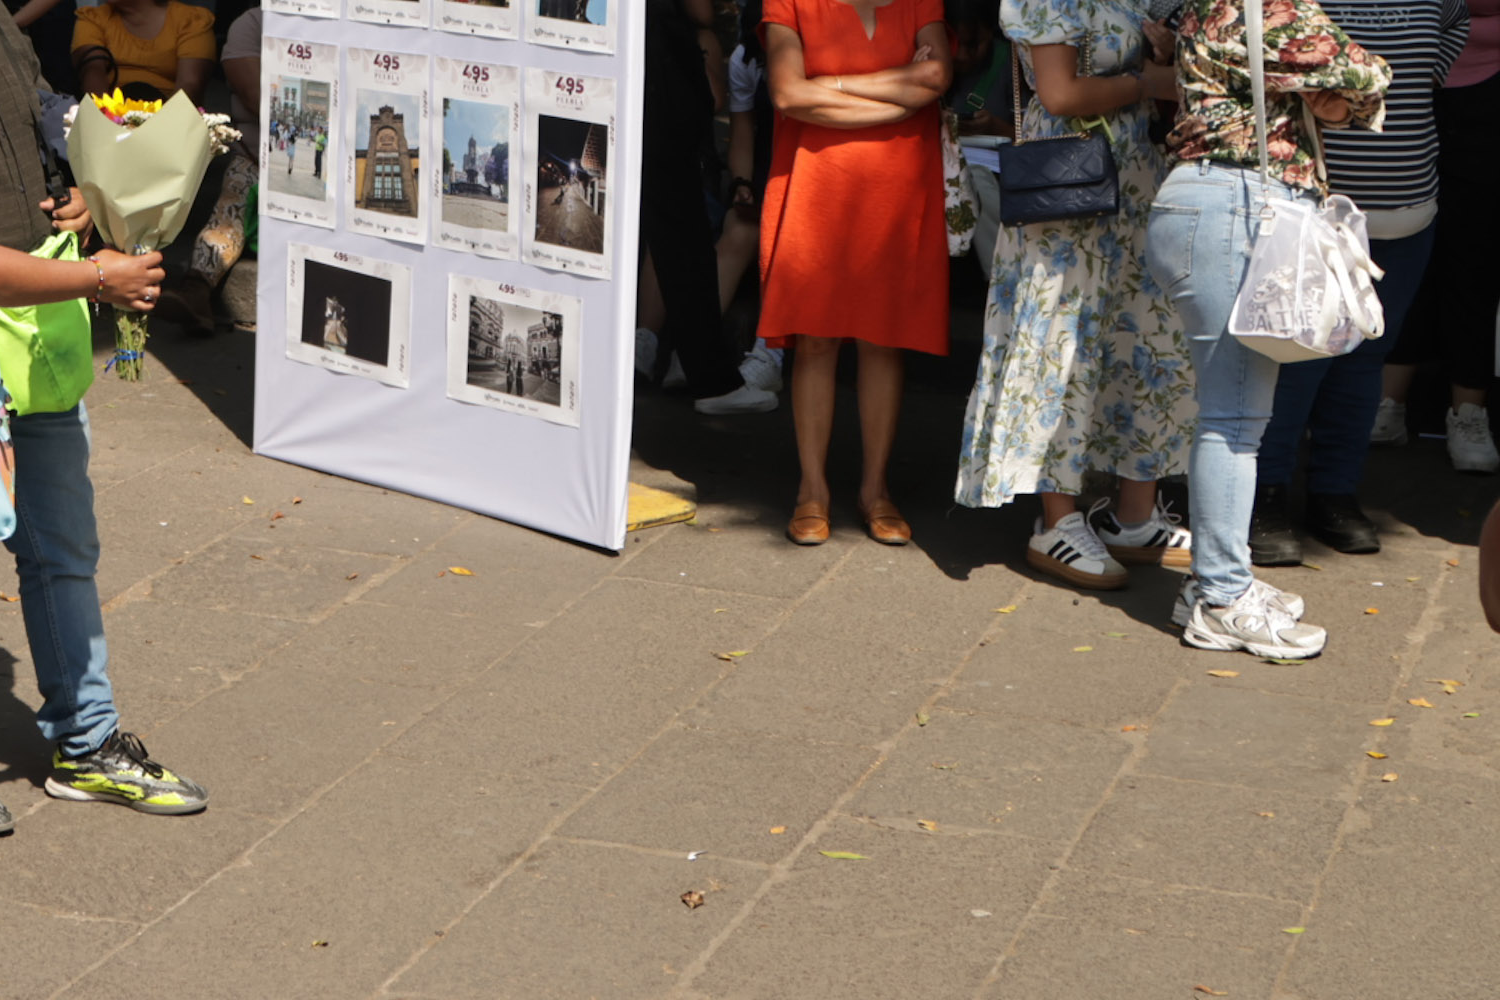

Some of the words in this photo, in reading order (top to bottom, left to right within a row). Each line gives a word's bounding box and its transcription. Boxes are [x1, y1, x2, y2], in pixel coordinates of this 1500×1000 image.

[287, 43, 312, 59] 495
[374, 54, 399, 69] 495
[462, 65, 489, 82] 495
[556, 77, 584, 93] 495
